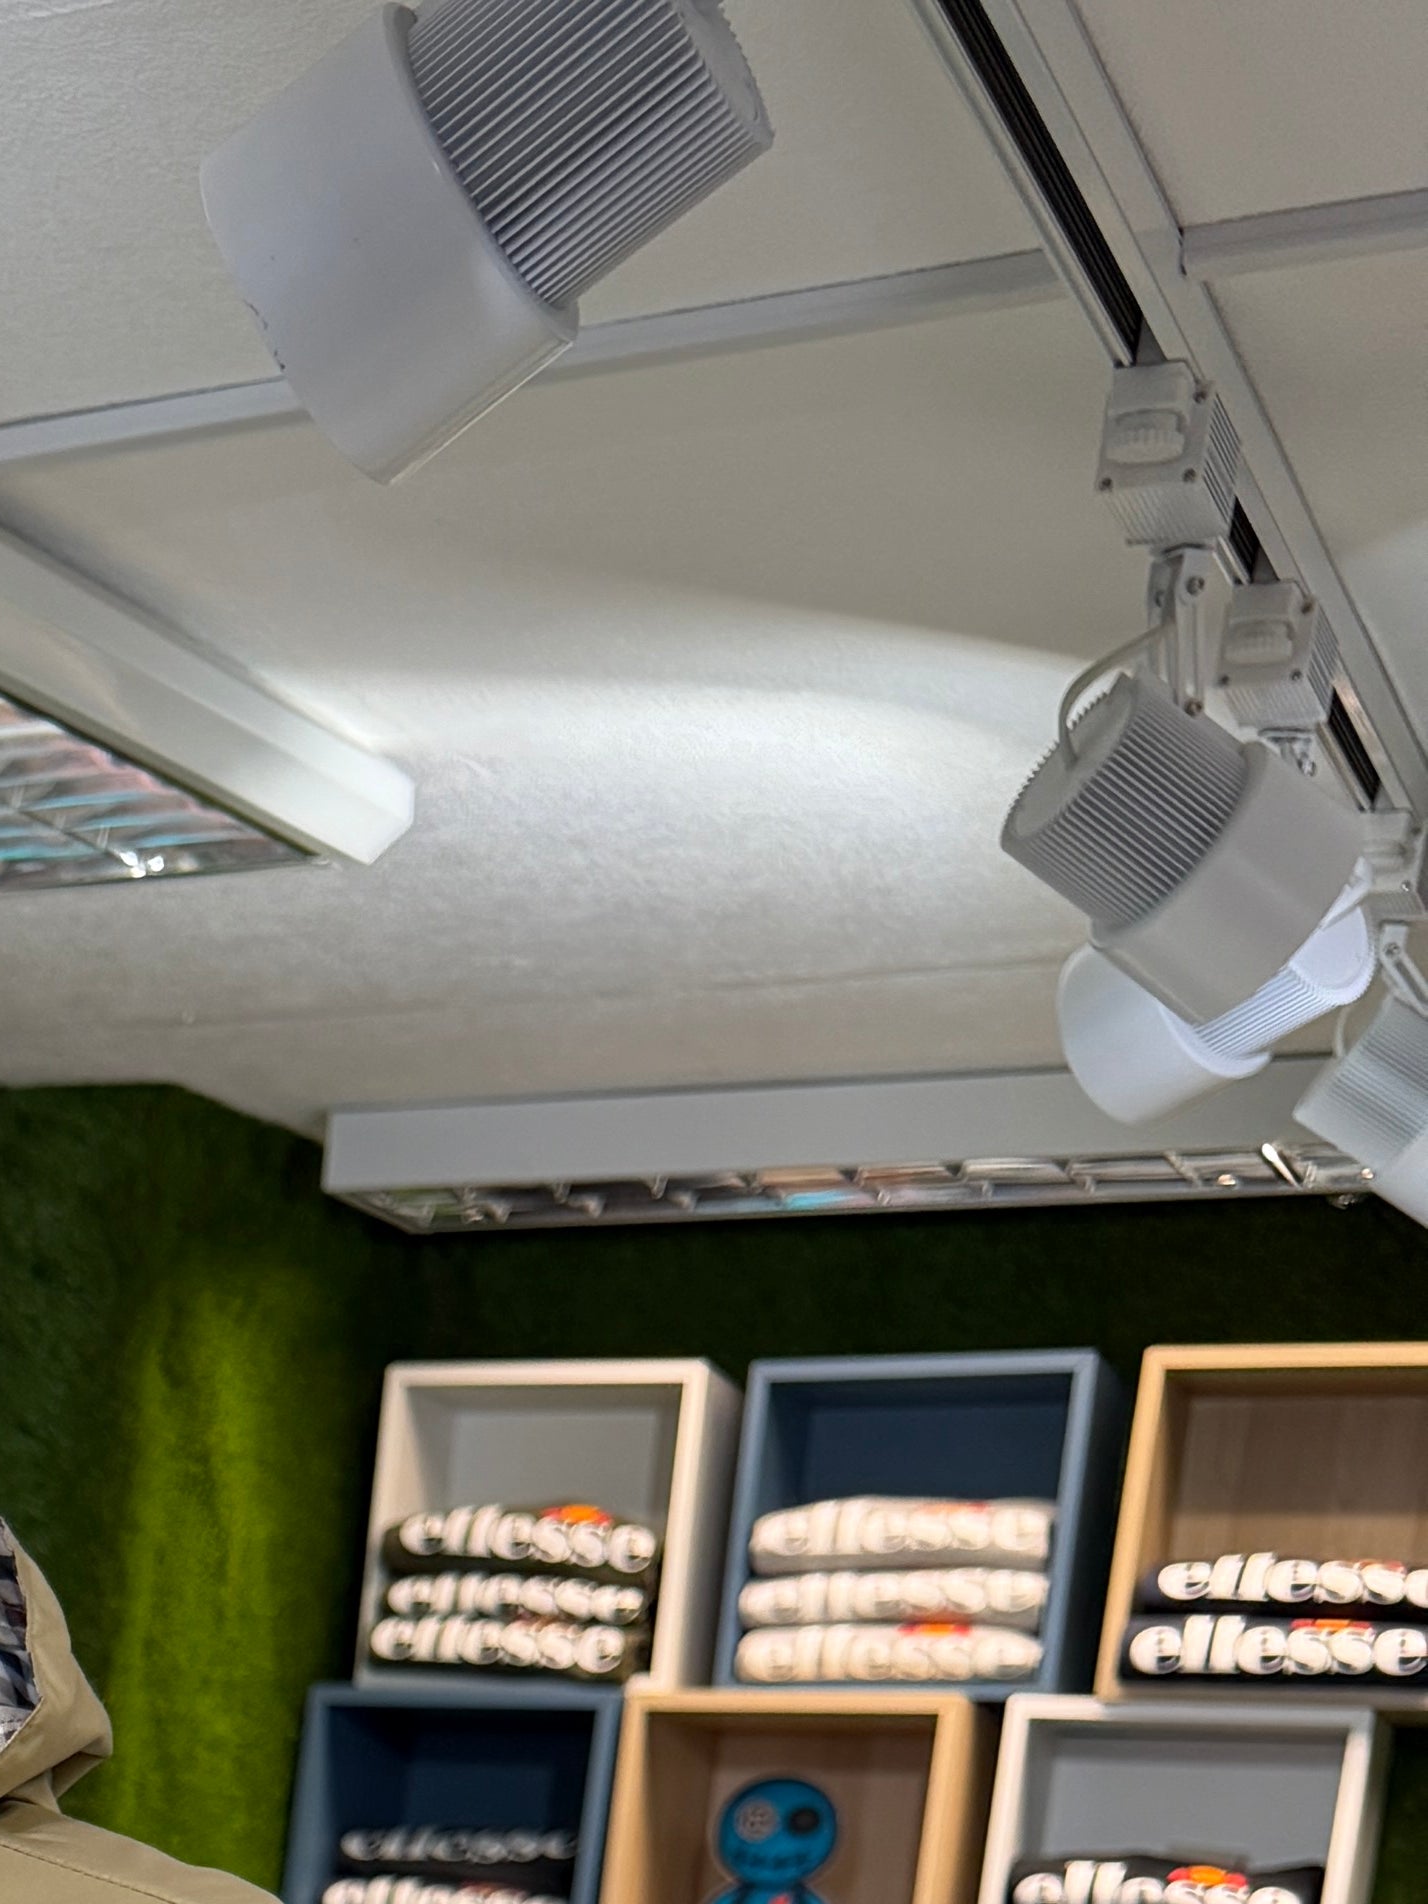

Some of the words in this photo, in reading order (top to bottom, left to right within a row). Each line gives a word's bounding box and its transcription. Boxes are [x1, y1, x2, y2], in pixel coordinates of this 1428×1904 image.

[399, 1503, 656, 1573] ellesse
[749, 1499, 1051, 1555] ellesse
[387, 1571, 645, 1625] ellesse
[370, 1613, 626, 1674] ellesse
[734, 1624, 1043, 1682] ellesse
[1129, 1614, 1428, 1676] ellesse
